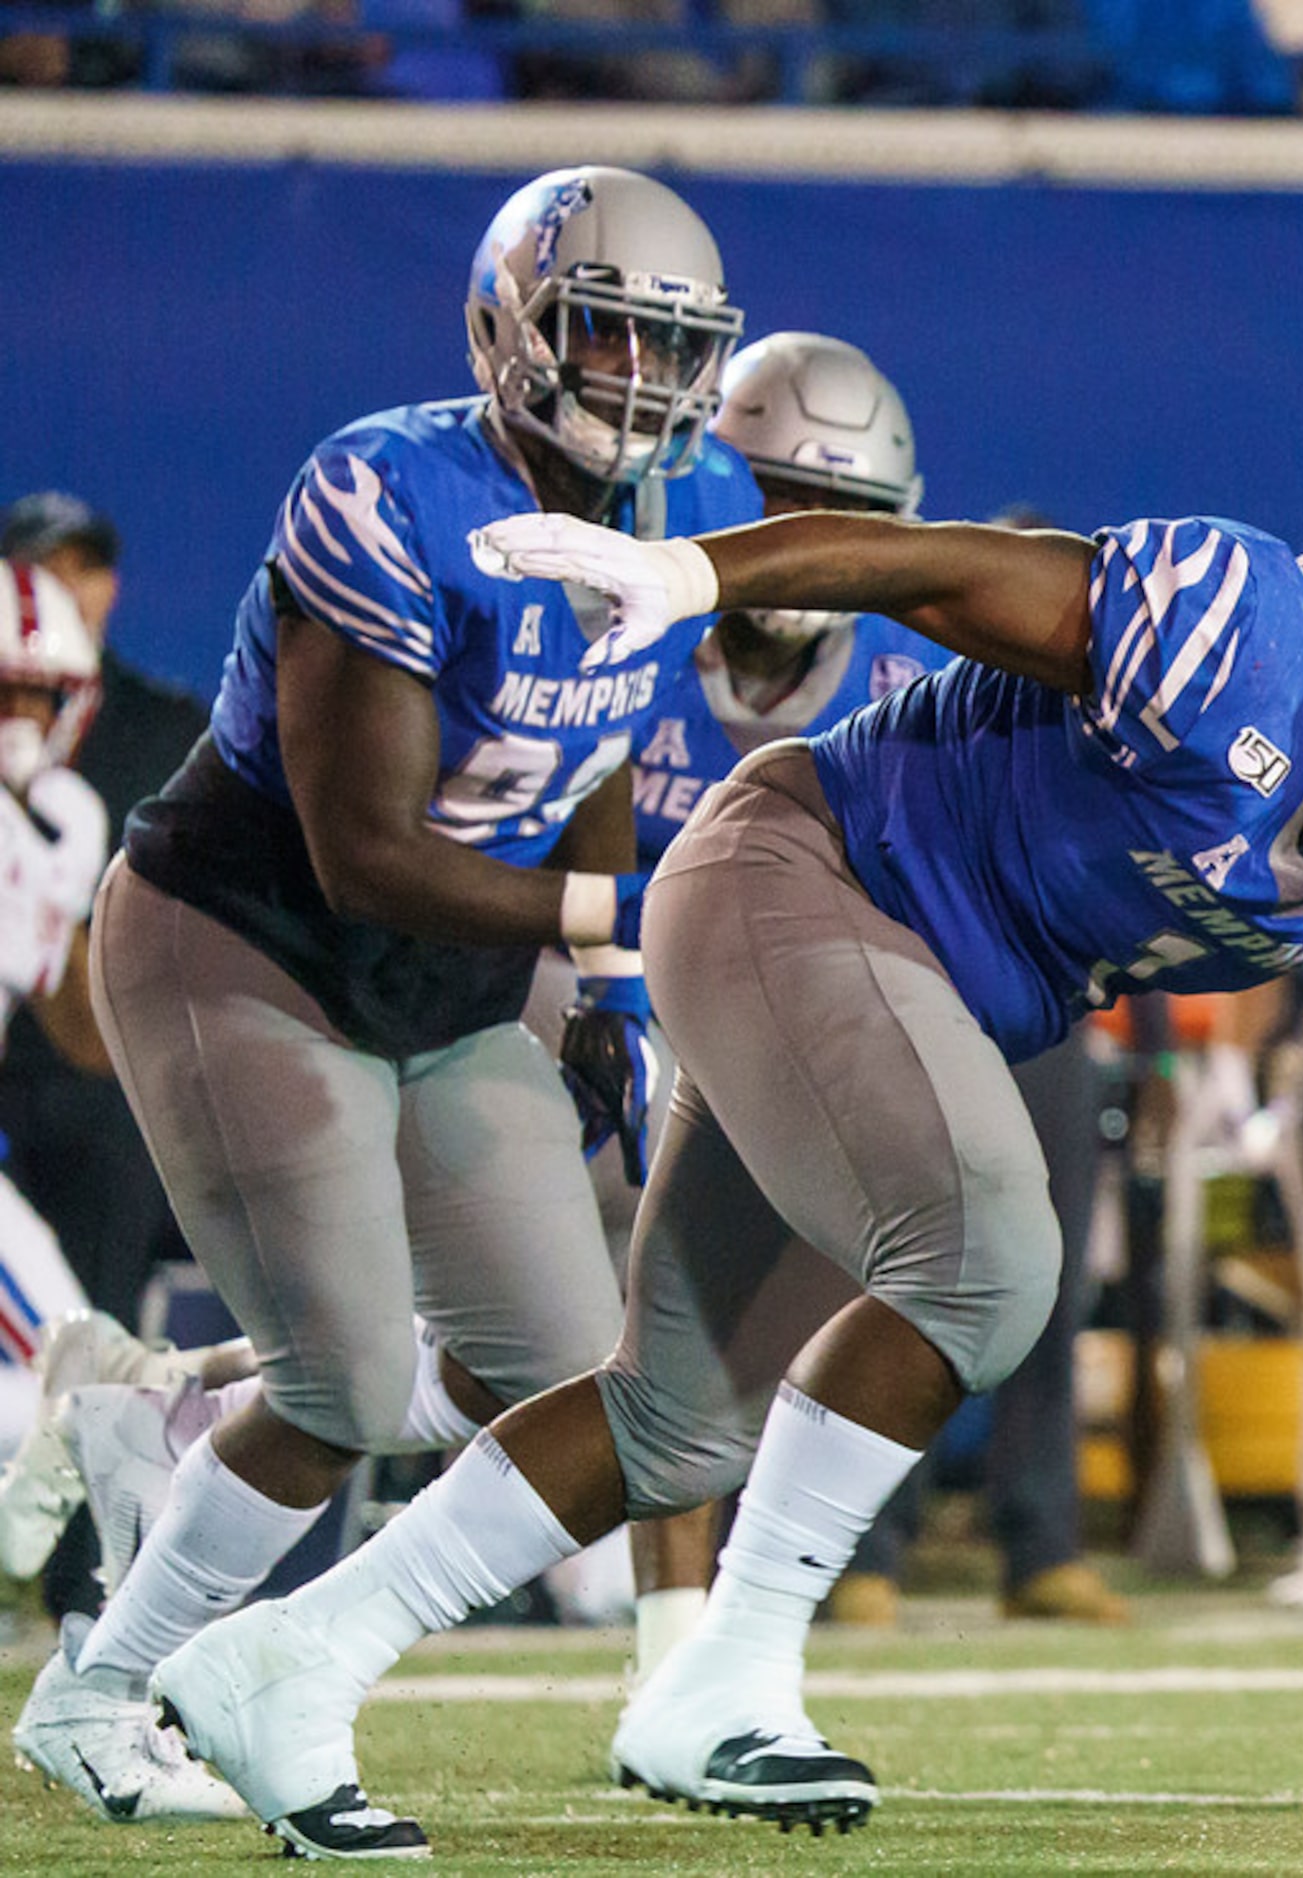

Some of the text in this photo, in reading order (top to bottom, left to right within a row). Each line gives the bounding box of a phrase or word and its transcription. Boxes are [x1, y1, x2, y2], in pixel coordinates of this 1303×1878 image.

[513, 603, 545, 656] A
[640, 718, 691, 769] A
[1236, 729, 1290, 795] 150
[1191, 833, 1250, 891] A
